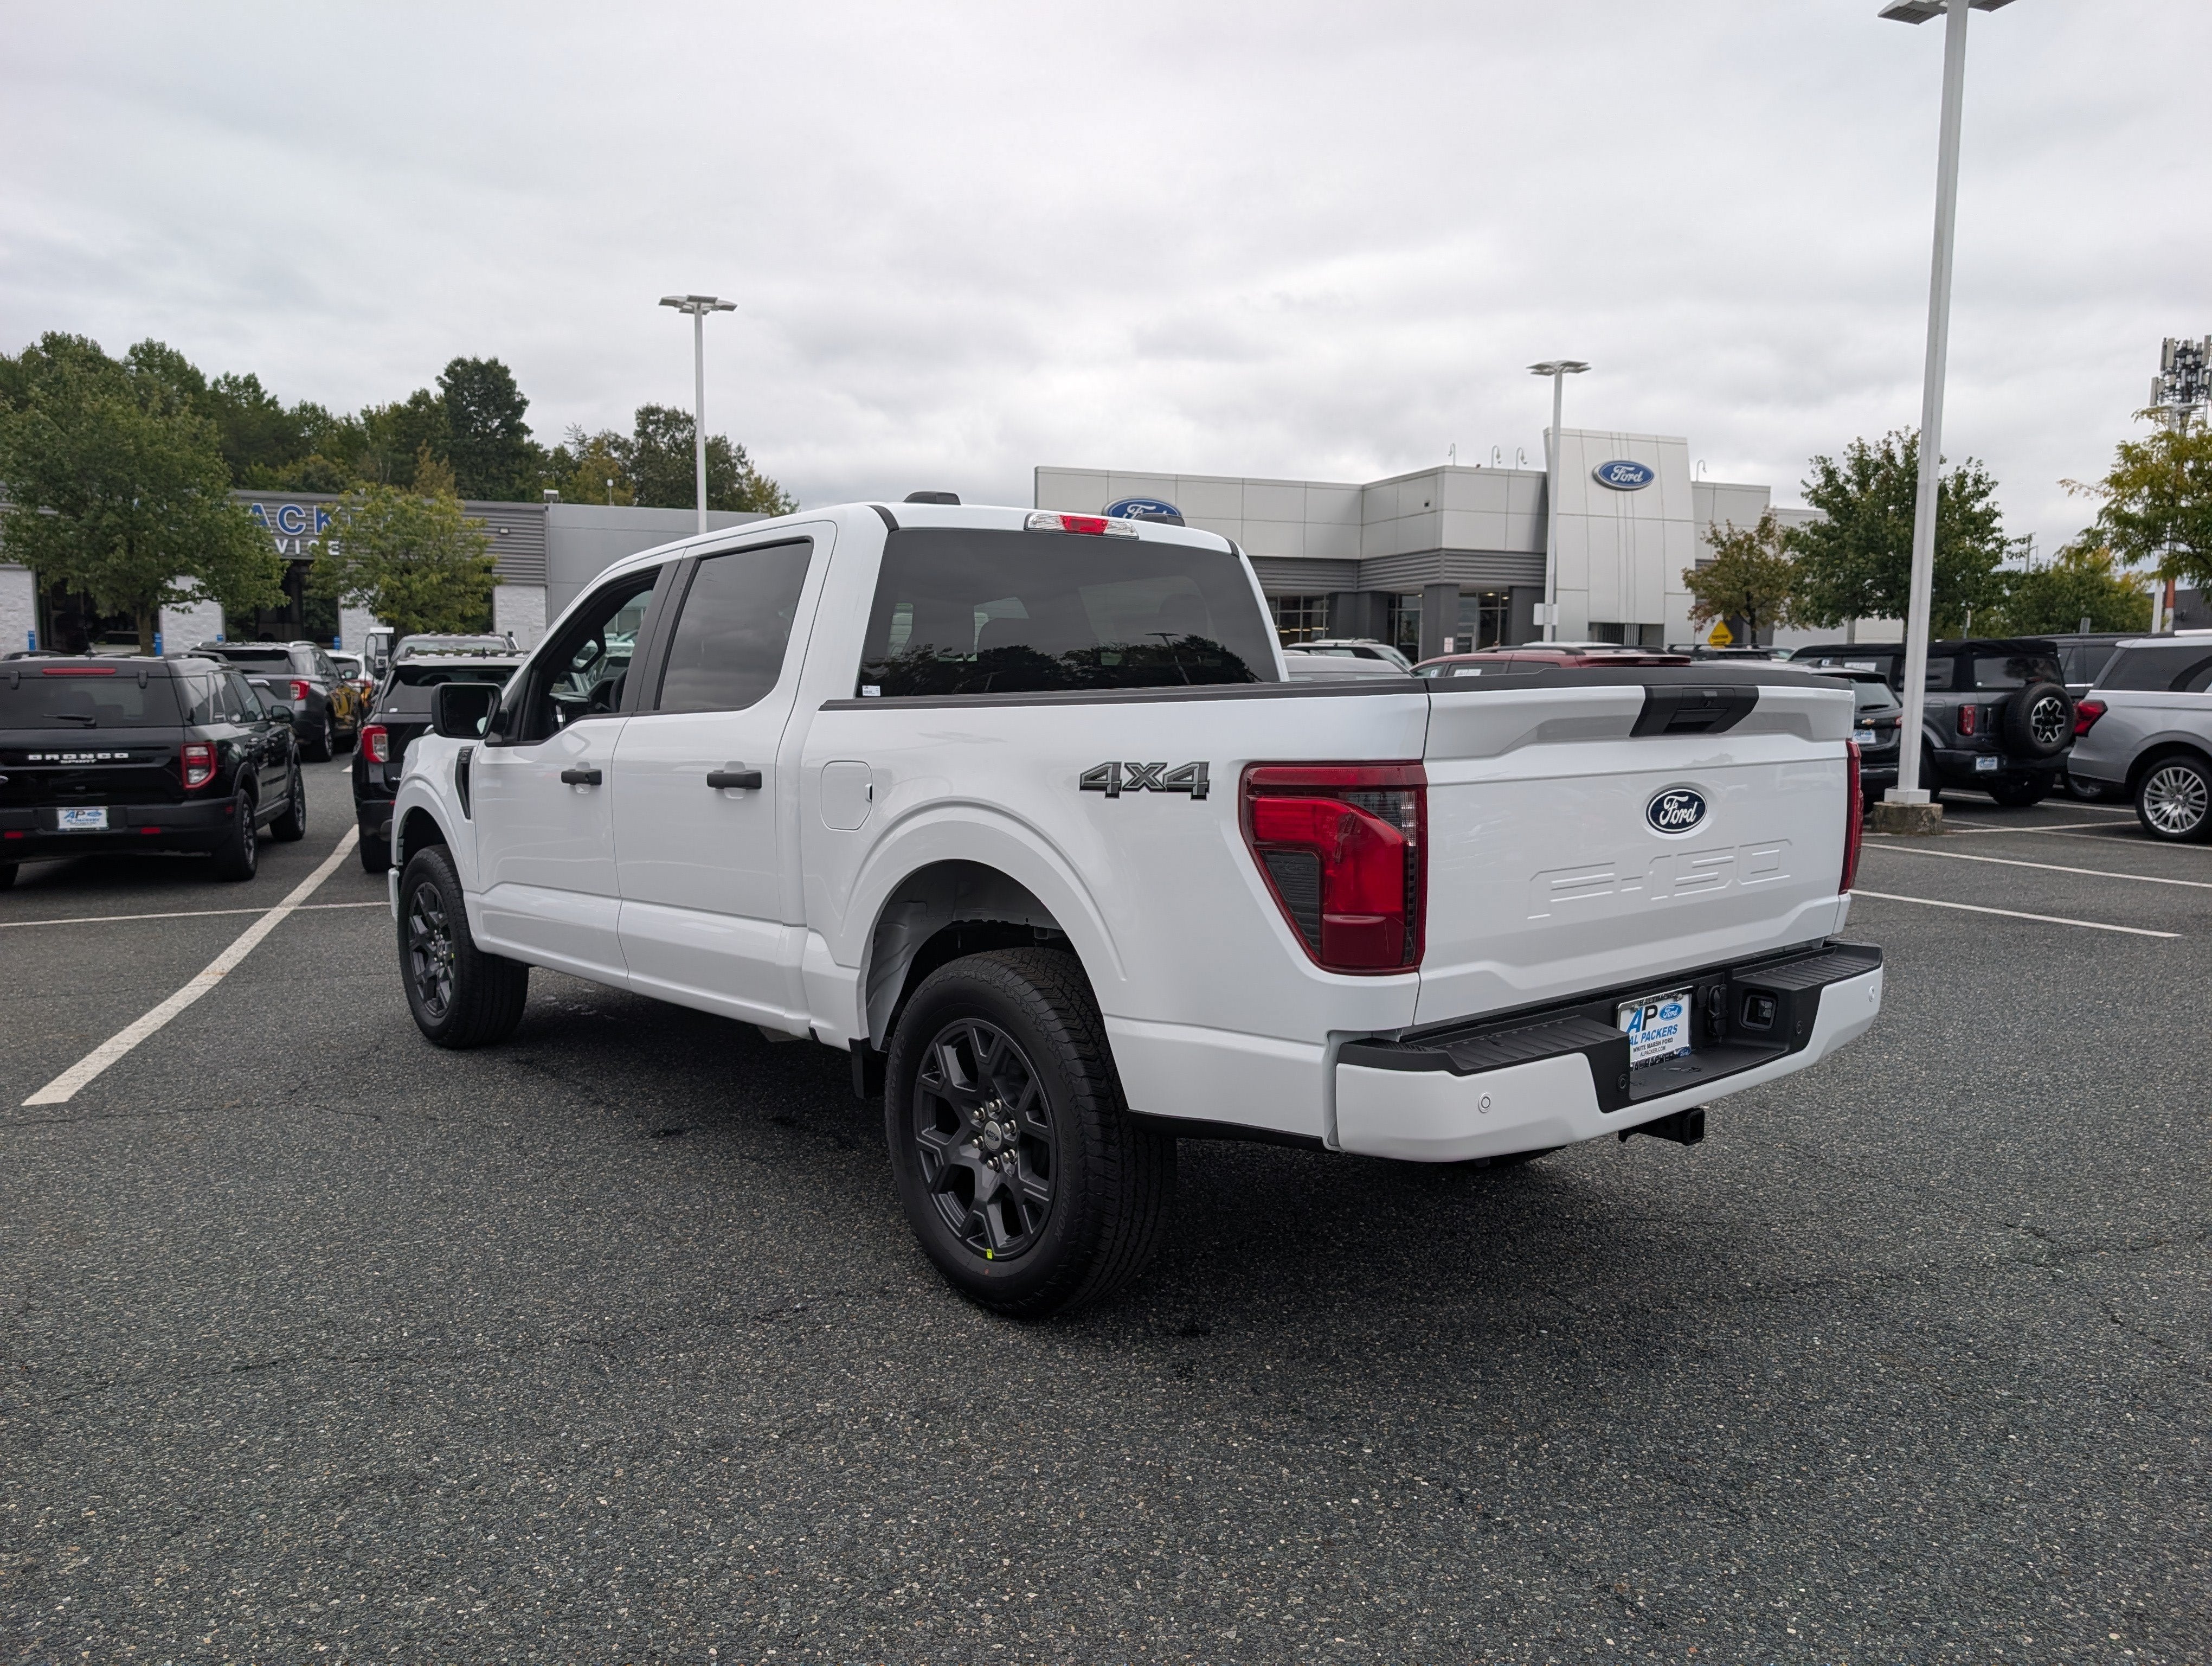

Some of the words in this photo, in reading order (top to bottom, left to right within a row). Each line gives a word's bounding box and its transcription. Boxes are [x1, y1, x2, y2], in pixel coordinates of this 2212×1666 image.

[1611, 465, 1644, 483] Ford
[28, 752, 129, 760] BRONCO
[1659, 795, 1698, 825] Ford
[1527, 838, 1793, 920] F-150
[1626, 1004, 1658, 1034] AP
[1662, 1005, 1679, 1018] Ford
[1629, 1034, 1638, 1046] AL
[1640, 1023, 1679, 1044] PACKERS
[1633, 1045, 1647, 1053] WHITE
[1647, 1040, 1662, 1049] MARSH
